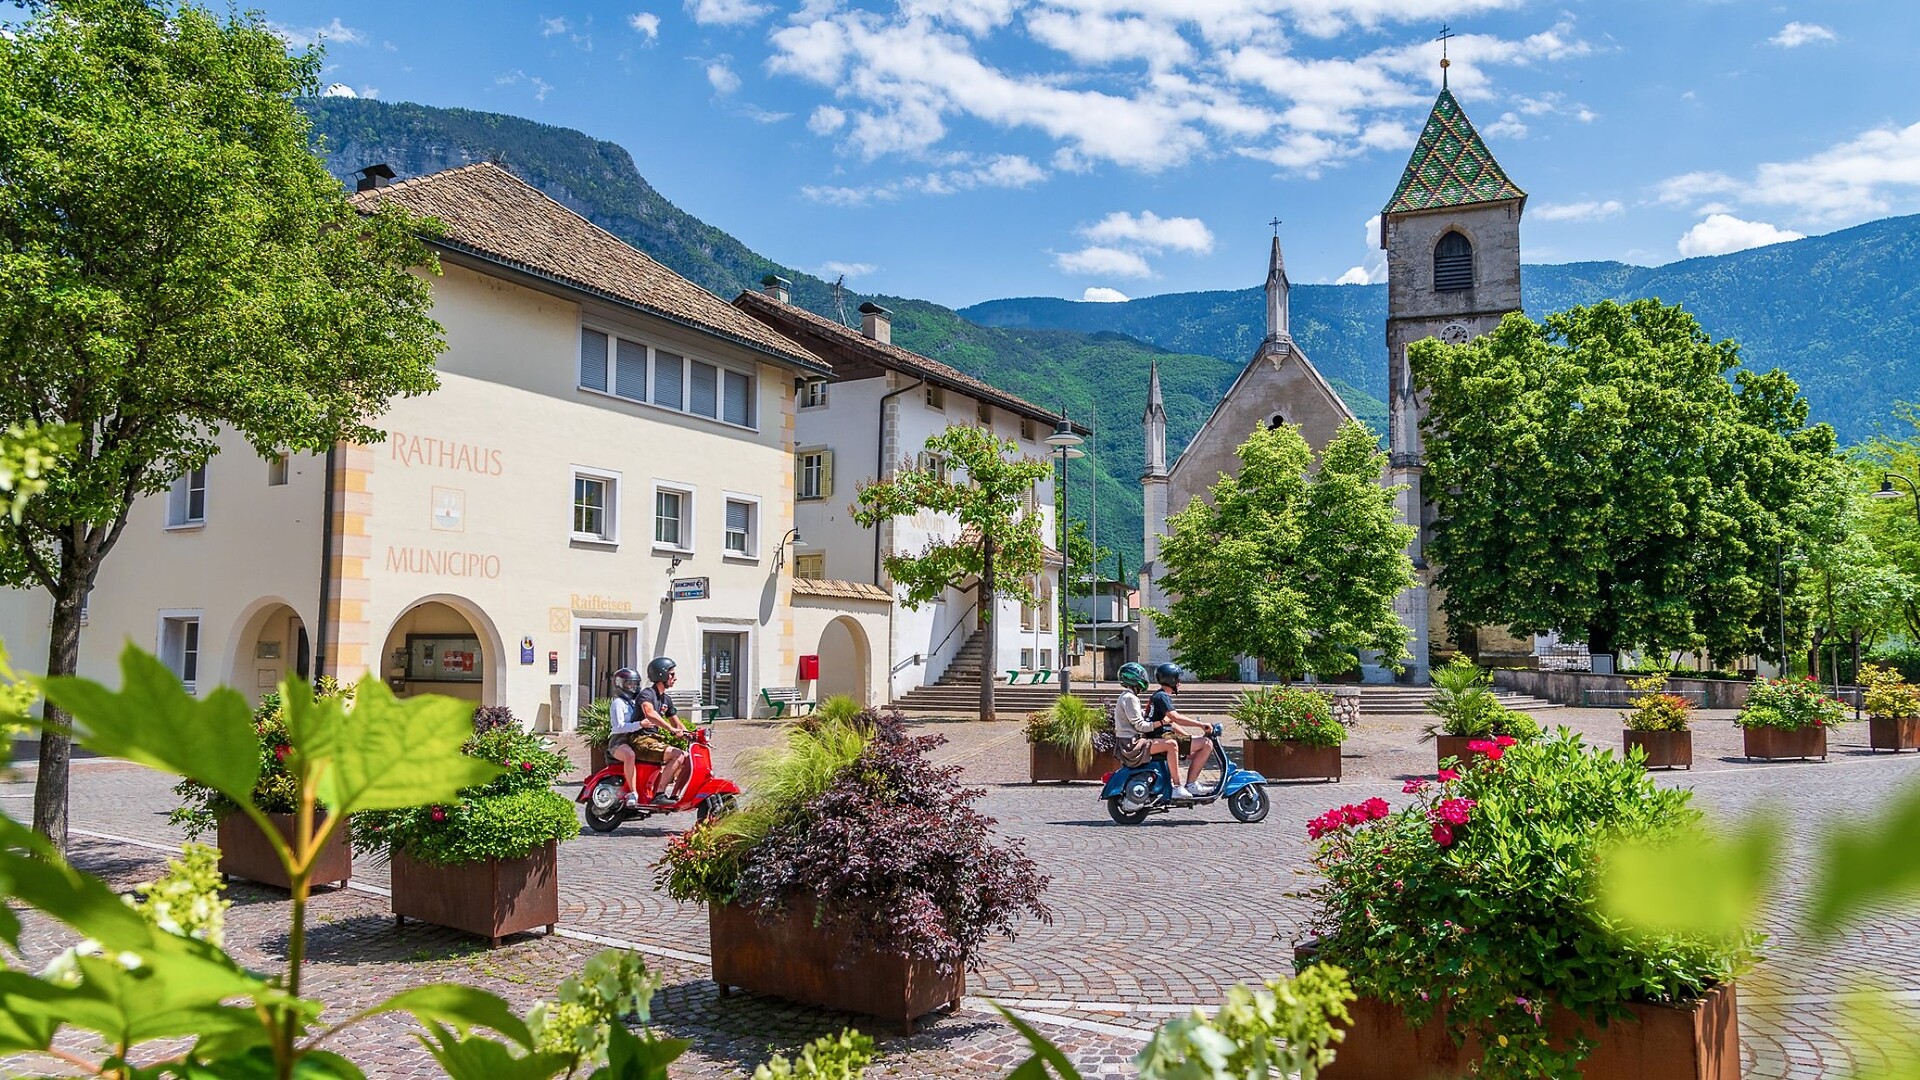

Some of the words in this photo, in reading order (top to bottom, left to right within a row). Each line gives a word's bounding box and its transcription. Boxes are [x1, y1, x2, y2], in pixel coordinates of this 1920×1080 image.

[391, 431, 503, 476] RATHAUS
[385, 546, 501, 579] MUNICIPIO
[571, 594, 631, 611] Raiffeisen
